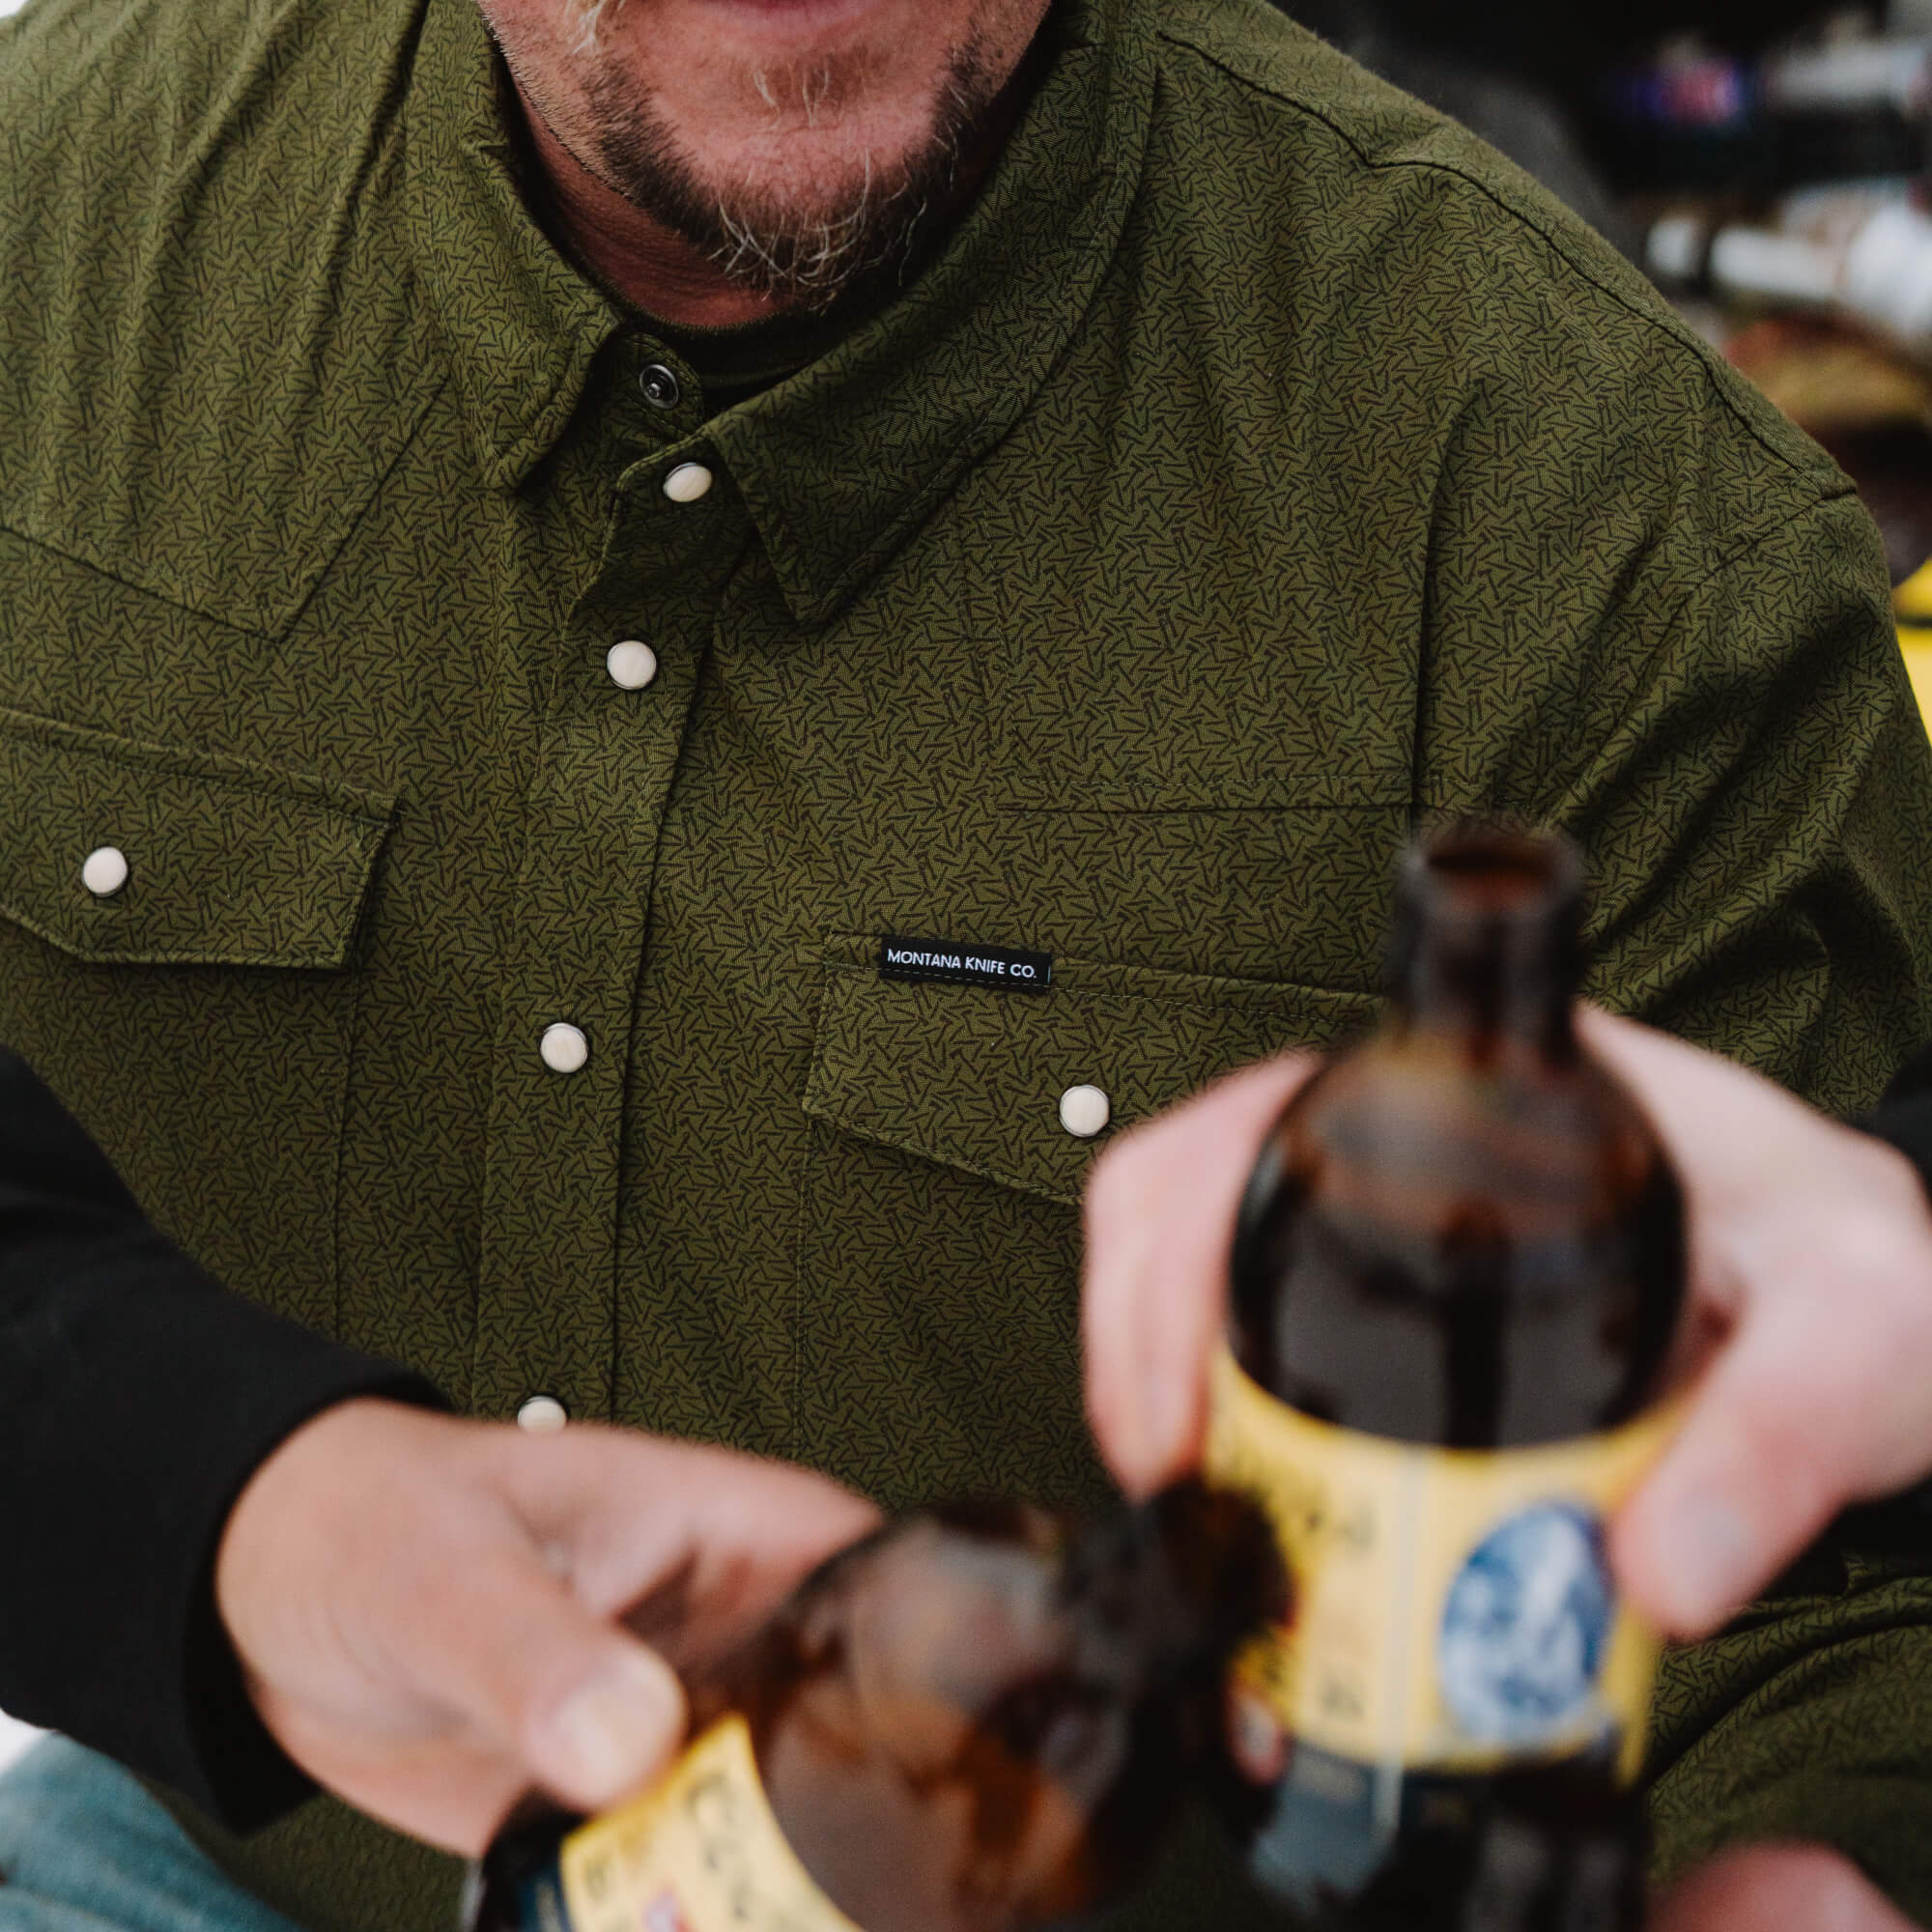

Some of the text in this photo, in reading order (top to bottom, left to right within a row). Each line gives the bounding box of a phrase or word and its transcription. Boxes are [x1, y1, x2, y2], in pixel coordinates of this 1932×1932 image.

[887, 949, 1037, 979] MONTANA KNIFE CO.
